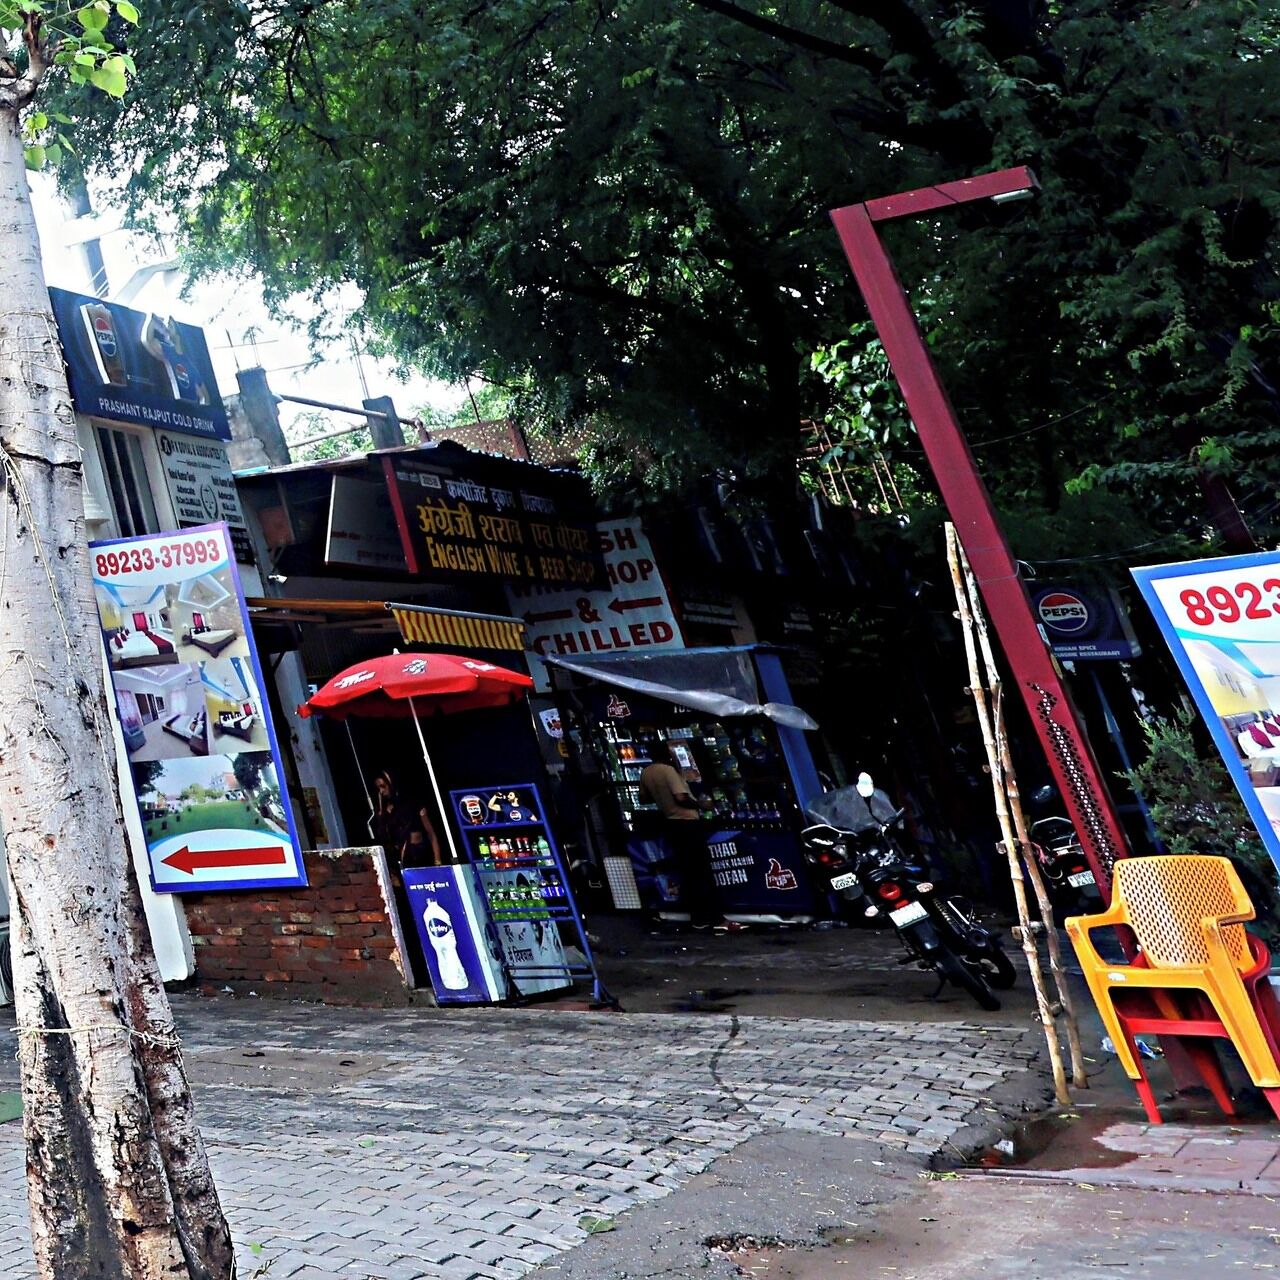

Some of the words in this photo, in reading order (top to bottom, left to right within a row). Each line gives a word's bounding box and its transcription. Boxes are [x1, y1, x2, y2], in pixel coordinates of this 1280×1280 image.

[98, 397, 141, 418] PRASHANT
[142, 406, 171, 425] RAJPUT
[172, 411, 192, 428] COLD
[193, 416, 216, 433] DRINK
[426, 535, 488, 575] ENGLISH
[606, 558, 654, 585] HOP
[576, 597, 602, 623] &
[1041, 607, 1086, 617] PEPSI
[533, 622, 675, 656] CHILLED
